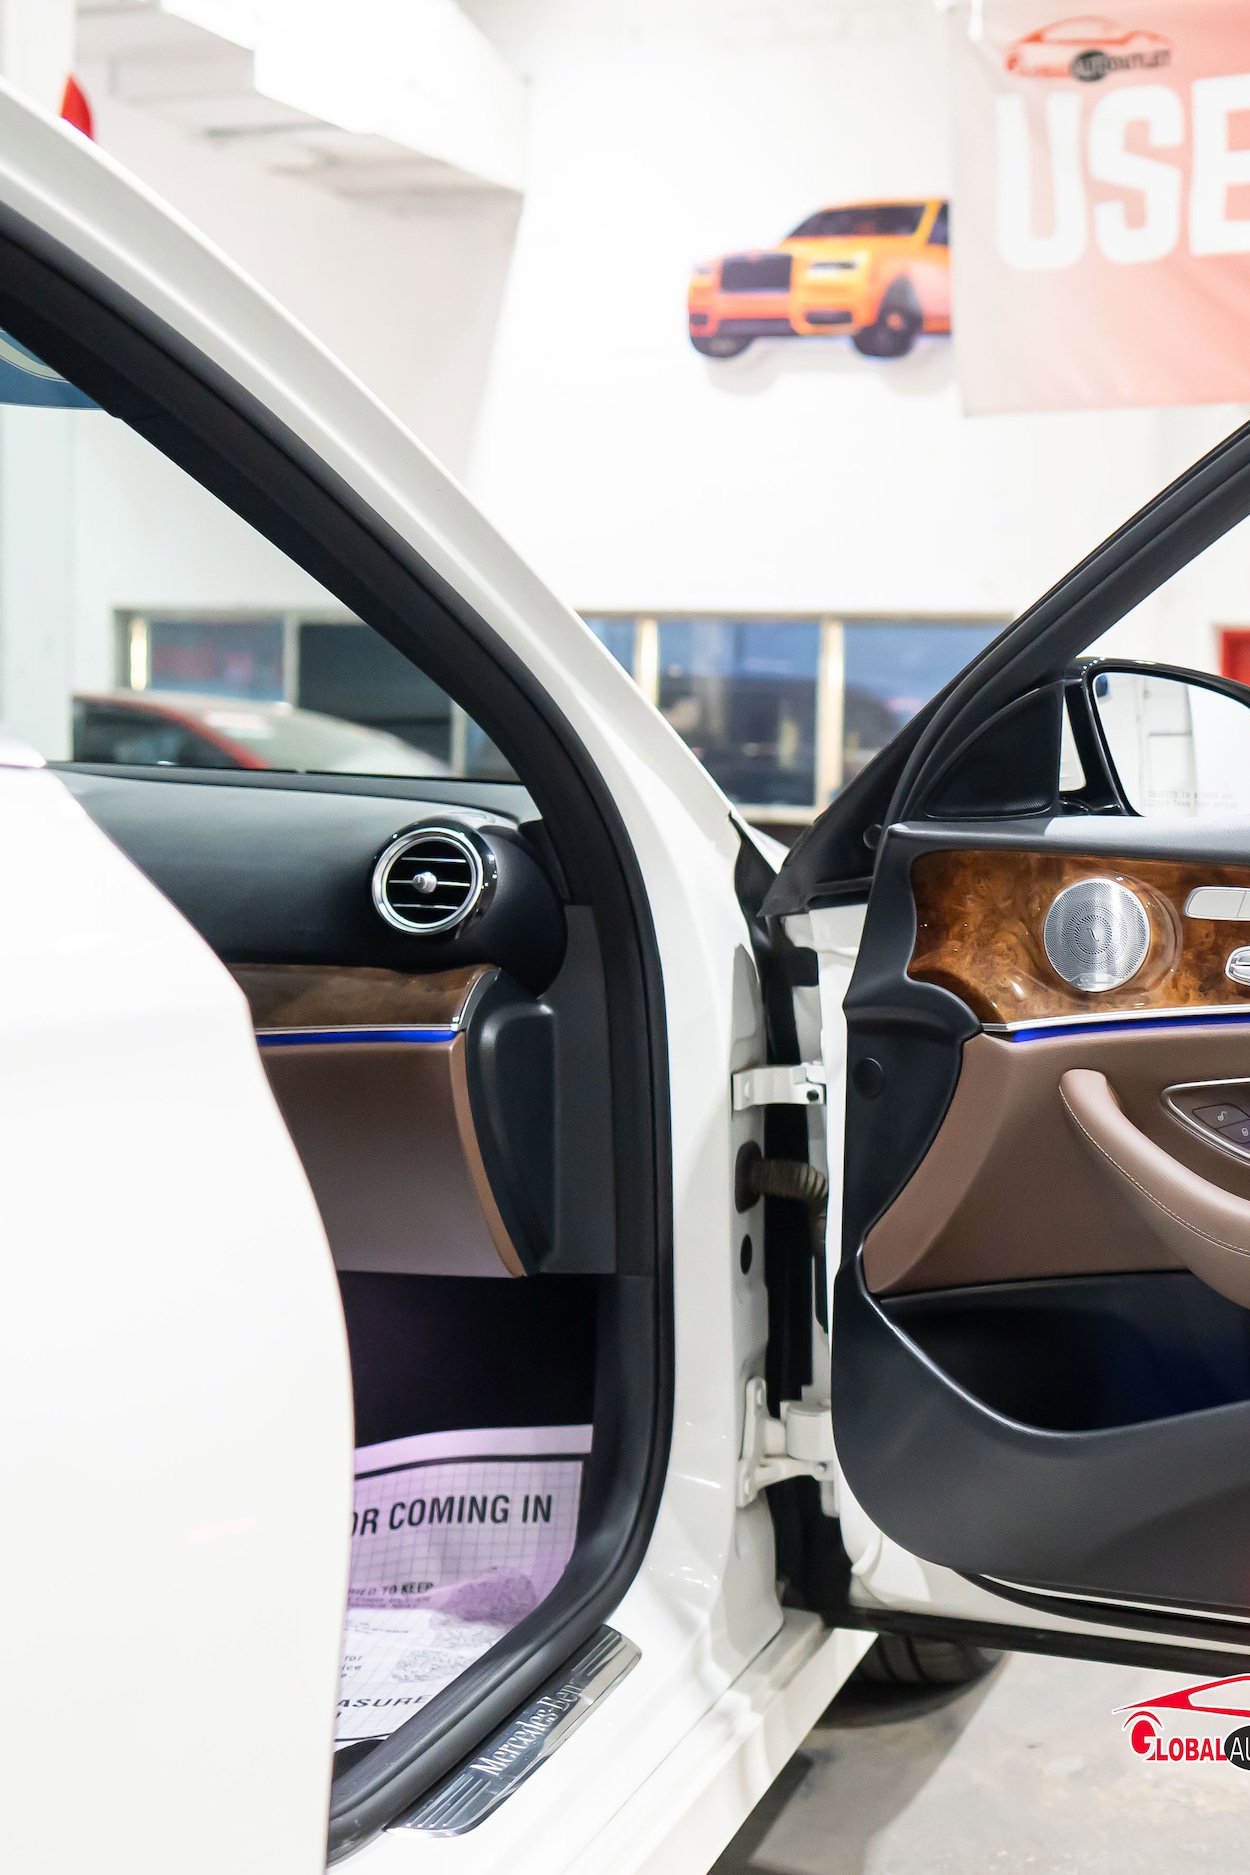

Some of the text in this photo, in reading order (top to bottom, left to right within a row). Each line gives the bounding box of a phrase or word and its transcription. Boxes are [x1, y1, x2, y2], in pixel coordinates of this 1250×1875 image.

[389, 1495, 510, 1531] COMING
[522, 1494, 552, 1524] IN
[401, 1581, 435, 1594] KEEP
